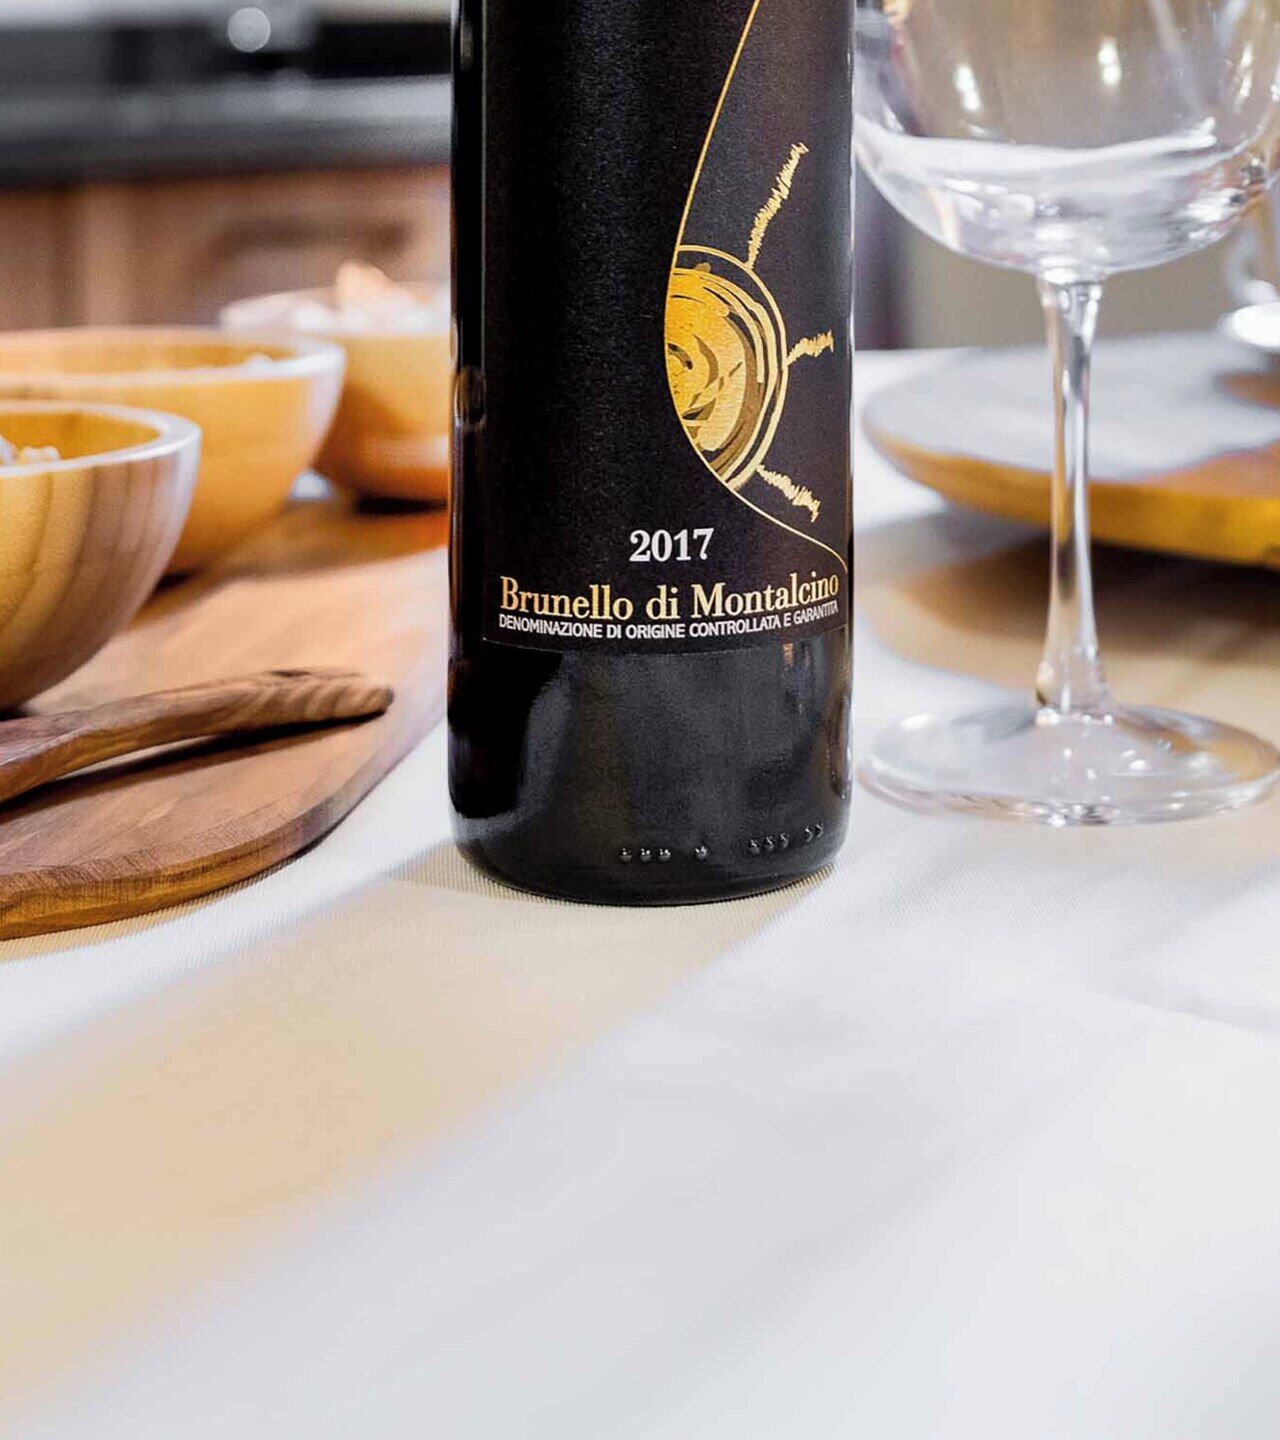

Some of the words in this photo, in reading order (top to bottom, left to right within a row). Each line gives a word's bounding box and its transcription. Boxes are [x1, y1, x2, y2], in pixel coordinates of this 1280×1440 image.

[628, 527, 714, 563] 2017
[500, 575, 634, 621] Brunello
[645, 584, 679, 620] di
[690, 571, 839, 620] Montalcino
[499, 613, 603, 638] DENOMINAZIONE
[606, 624, 622, 639] DI
[625, 623, 686, 639] ORIGINE
[689, 614, 782, 638] CONTROLLATA
[783, 612, 793, 628] E
[793, 600, 839, 626] GARANTITA
